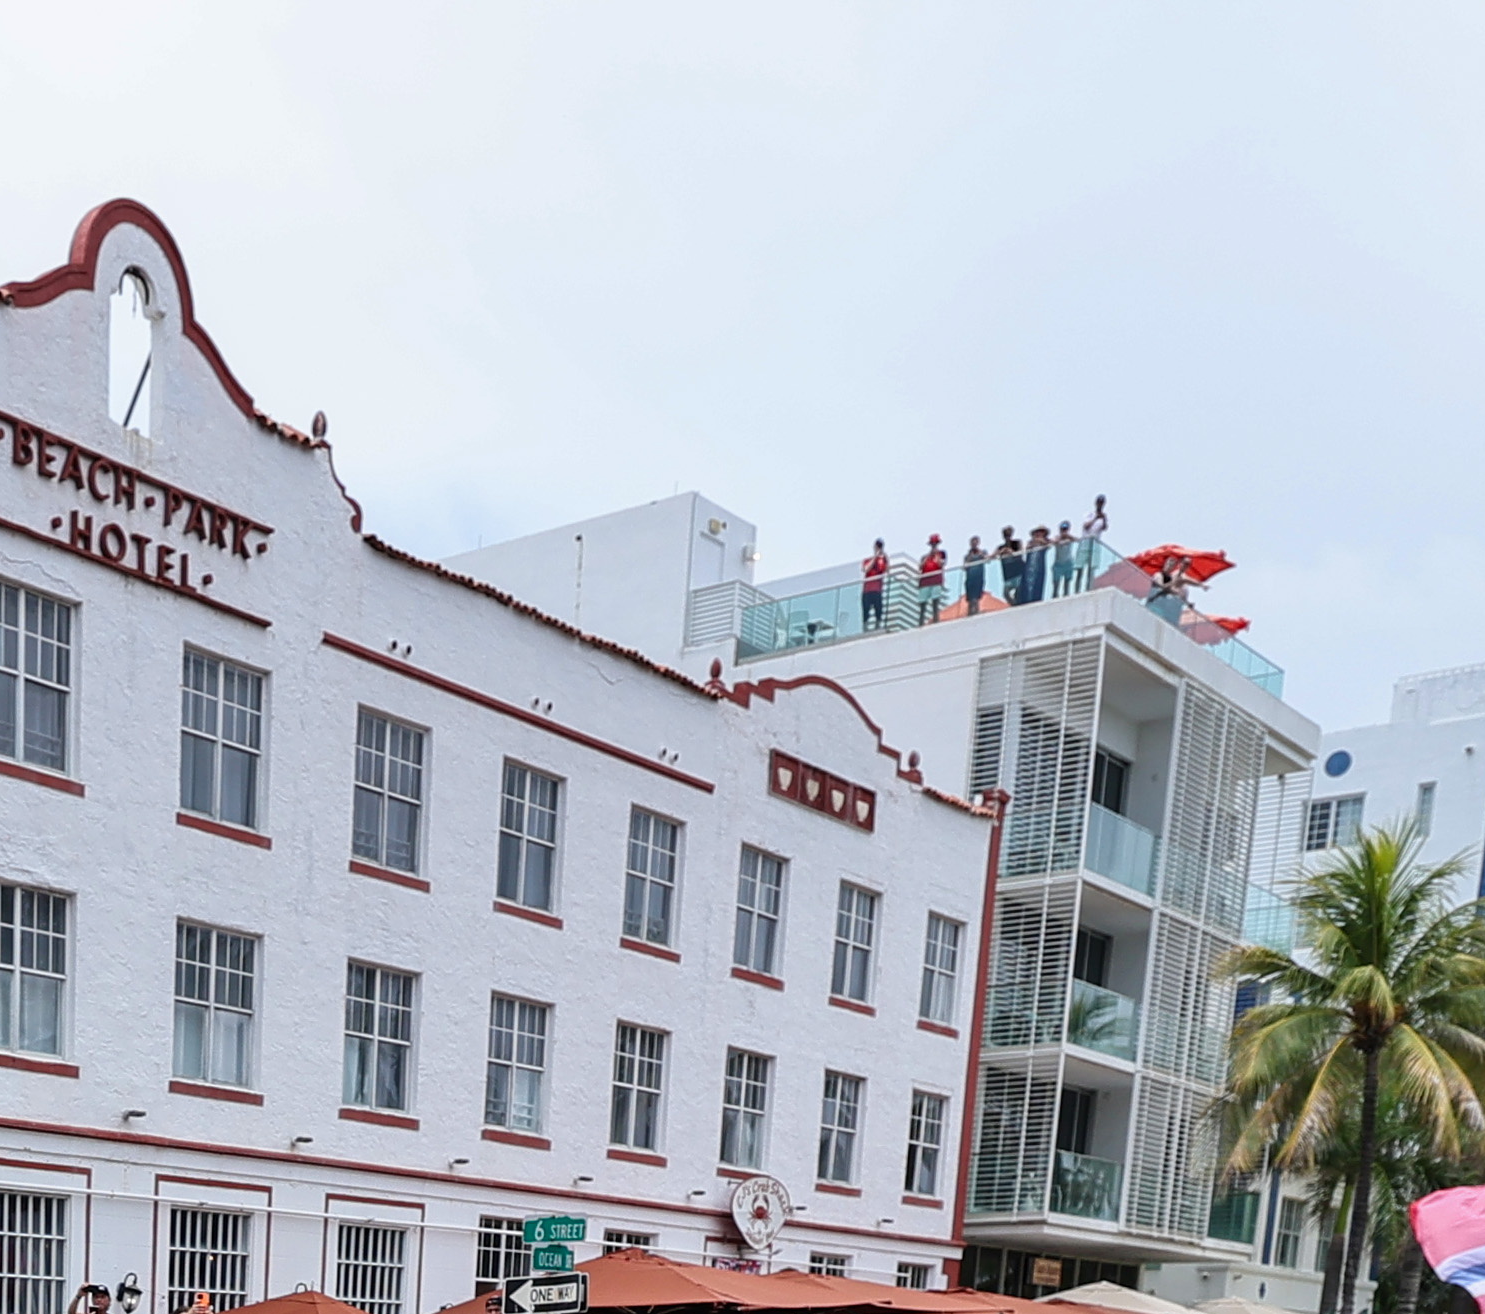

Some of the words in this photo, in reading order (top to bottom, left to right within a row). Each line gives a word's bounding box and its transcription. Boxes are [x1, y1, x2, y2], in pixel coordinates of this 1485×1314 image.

[10, 426, 138, 514] BEACH
[162, 488, 260, 562] PARK
[70, 510, 200, 592] HOTEL
[534, 1221, 545, 1241] 6
[550, 1223, 584, 1241] STREET
[538, 1252, 561, 1268] OCEAN
[529, 1287, 553, 1304] ONE
[557, 1285, 578, 1301] WAY
